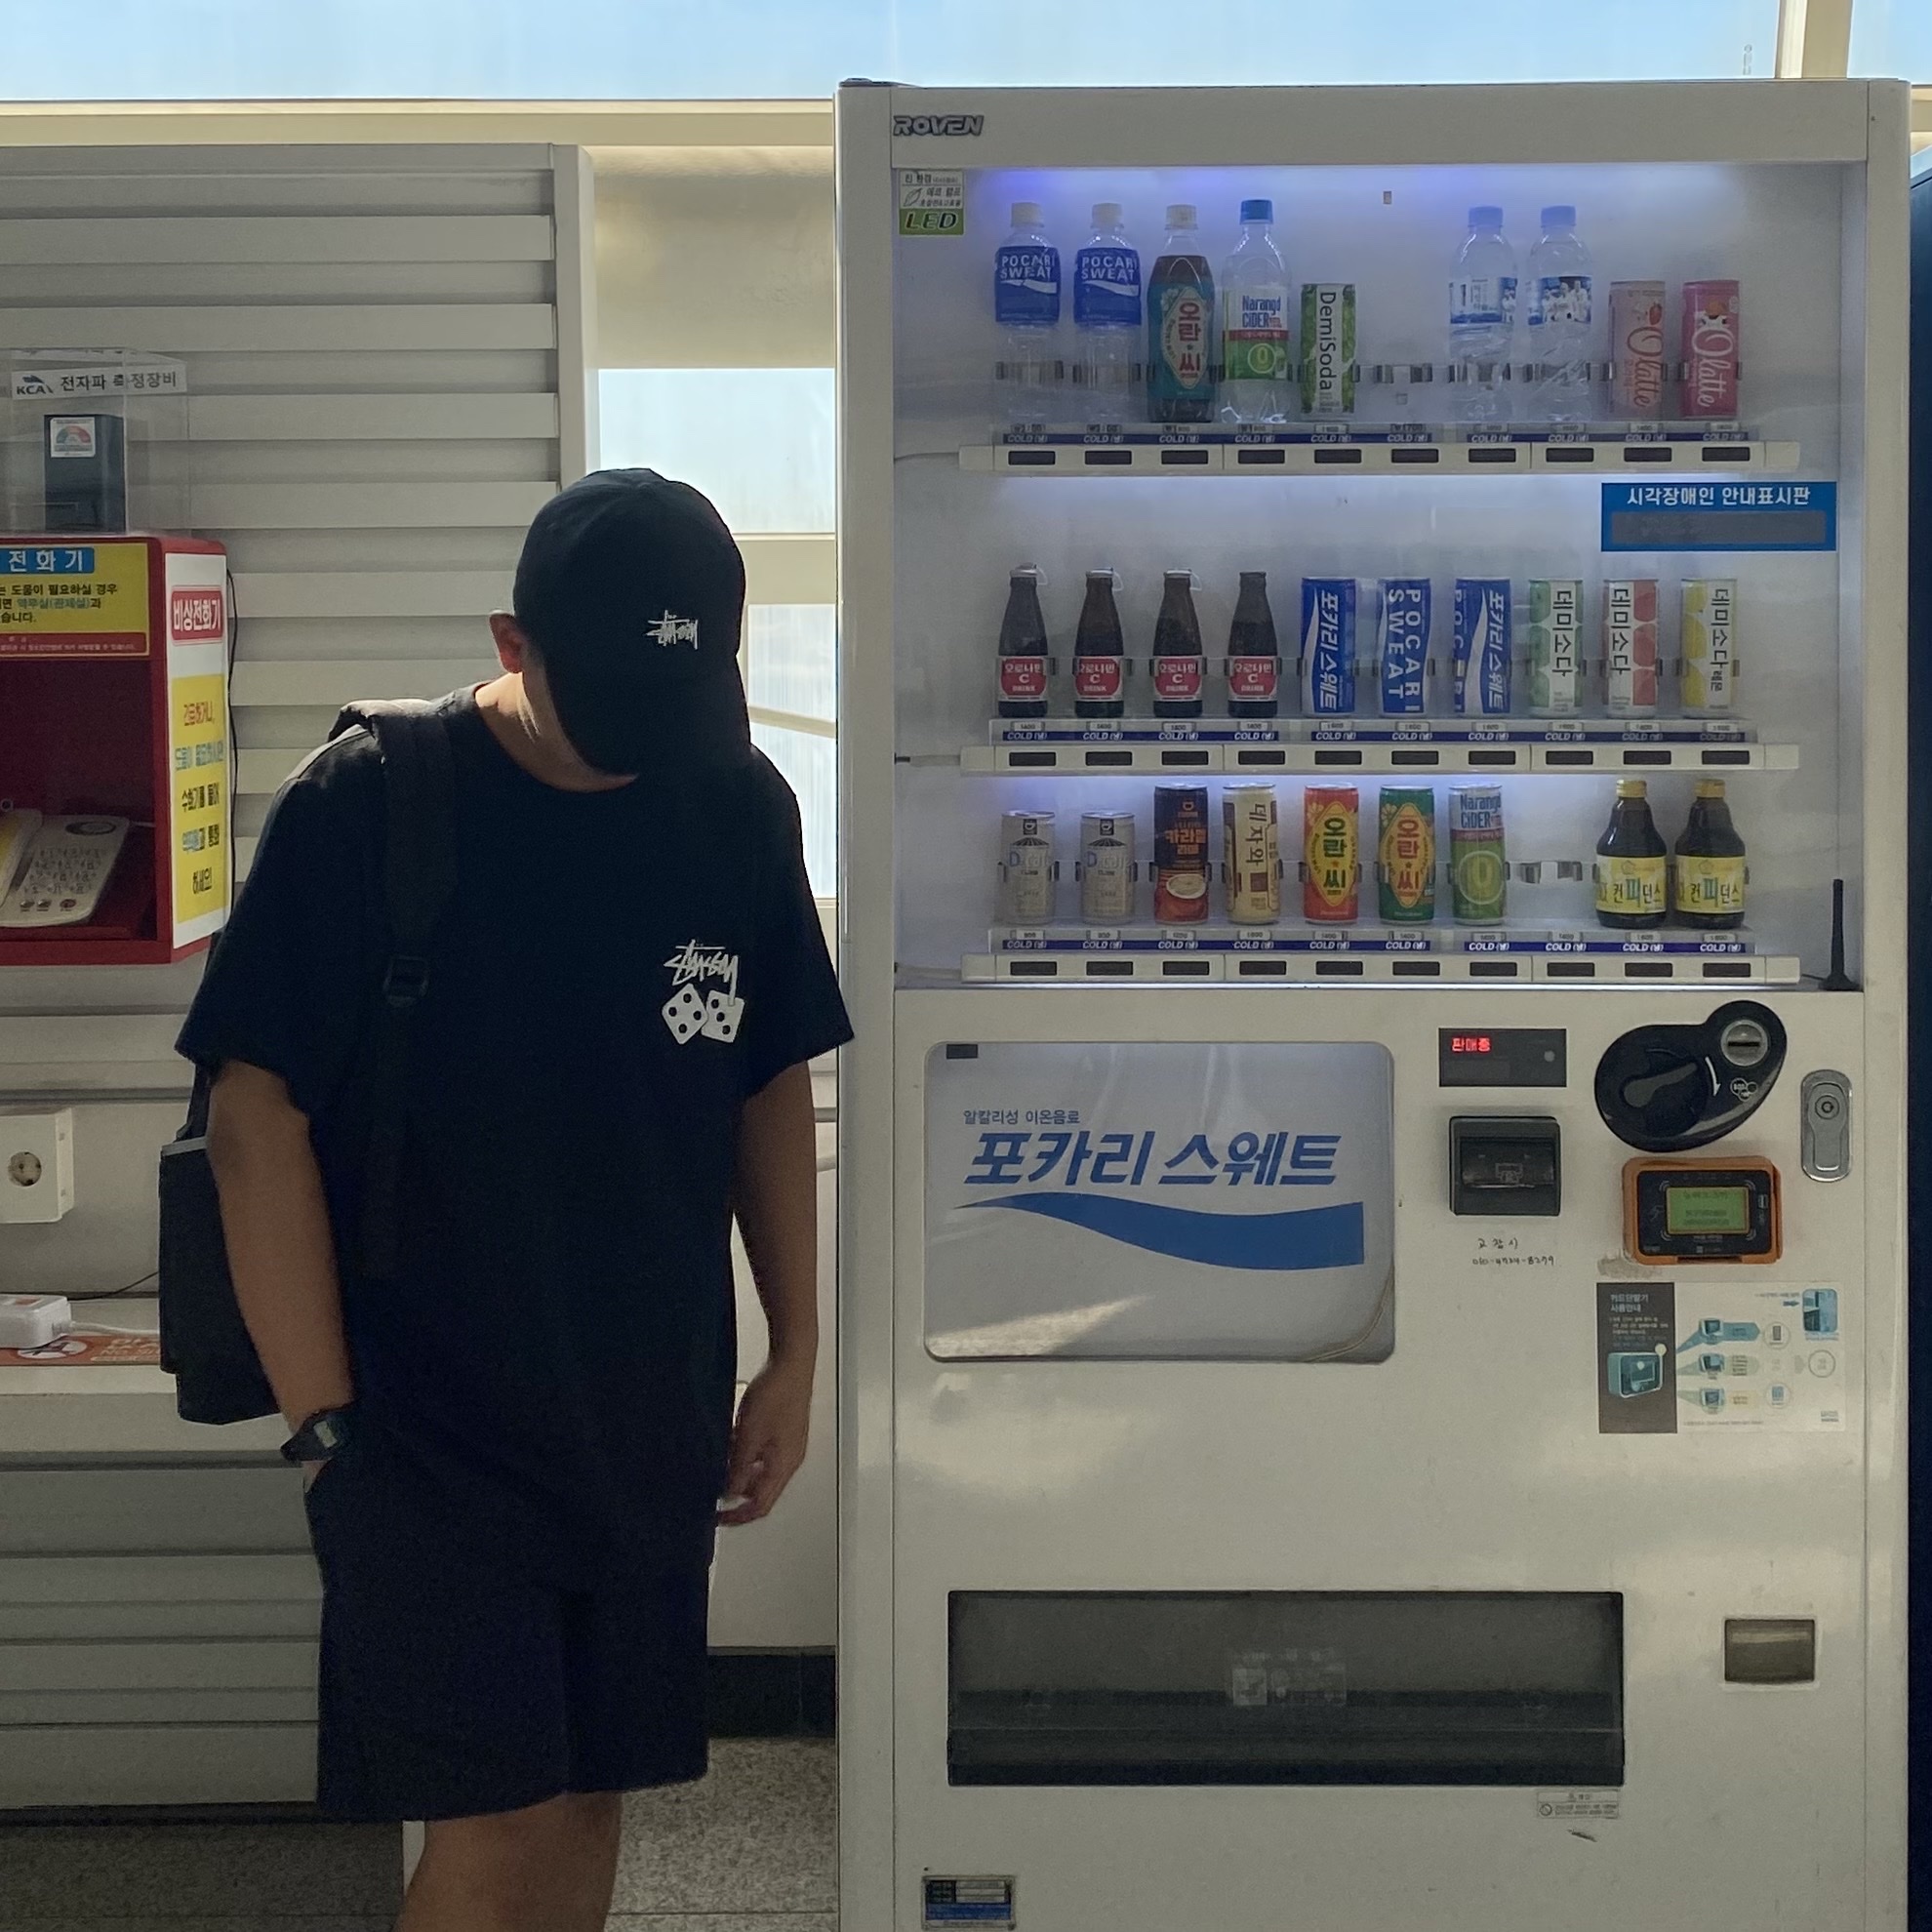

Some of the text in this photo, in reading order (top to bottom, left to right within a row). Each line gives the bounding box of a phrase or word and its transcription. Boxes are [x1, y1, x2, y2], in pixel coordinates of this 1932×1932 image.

[893, 115, 985, 137] ROVEN
[906, 211, 957, 230] LED
[1001, 255, 1056, 267] POCARI
[1081, 256, 1139, 268] POCARI
[1000, 266, 1052, 279] SWEAT
[1081, 267, 1135, 281] SWEAT
[1318, 292, 1337, 391] DemiSoda
[17, 385, 47, 395] KCA
[60, 375, 106, 392] 전자파
[1627, 486, 1811, 505] 시각장애인 안내표시판
[9, 550, 83, 572] 전화기
[11, 584, 44, 596] 도움이
[49, 584, 92, 596] 필요하실
[96, 584, 118, 595] 경우
[0, 598, 13, 610] 면
[173, 598, 221, 632] 비상전화기
[1552, 590, 1574, 677] 데미소다
[1610, 589, 1630, 675] 데미소다
[1709, 589, 1730, 669] 데미소다
[1388, 588, 1405, 700] SWEAT
[1405, 588, 1422, 711] POCARI
[1019, 673, 1029, 684] C
[1089, 673, 1101, 684] C
[1172, 673, 1184, 684] C
[1247, 673, 1259, 684] C
[1245, 803, 1268, 866] 데자와
[1613, 877, 1663, 908] 컨피던스
[1690, 877, 1740, 908] 컨피던스
[1082, 941, 1107, 949] COLD
[1386, 942, 1411, 950] COLD
[1469, 943, 1494, 951] COLD
[1546, 943, 1571, 951] COLD
[1700, 944, 1725, 952] COLD
[963, 1108, 1081, 1125] 알칼리성 이온음료
